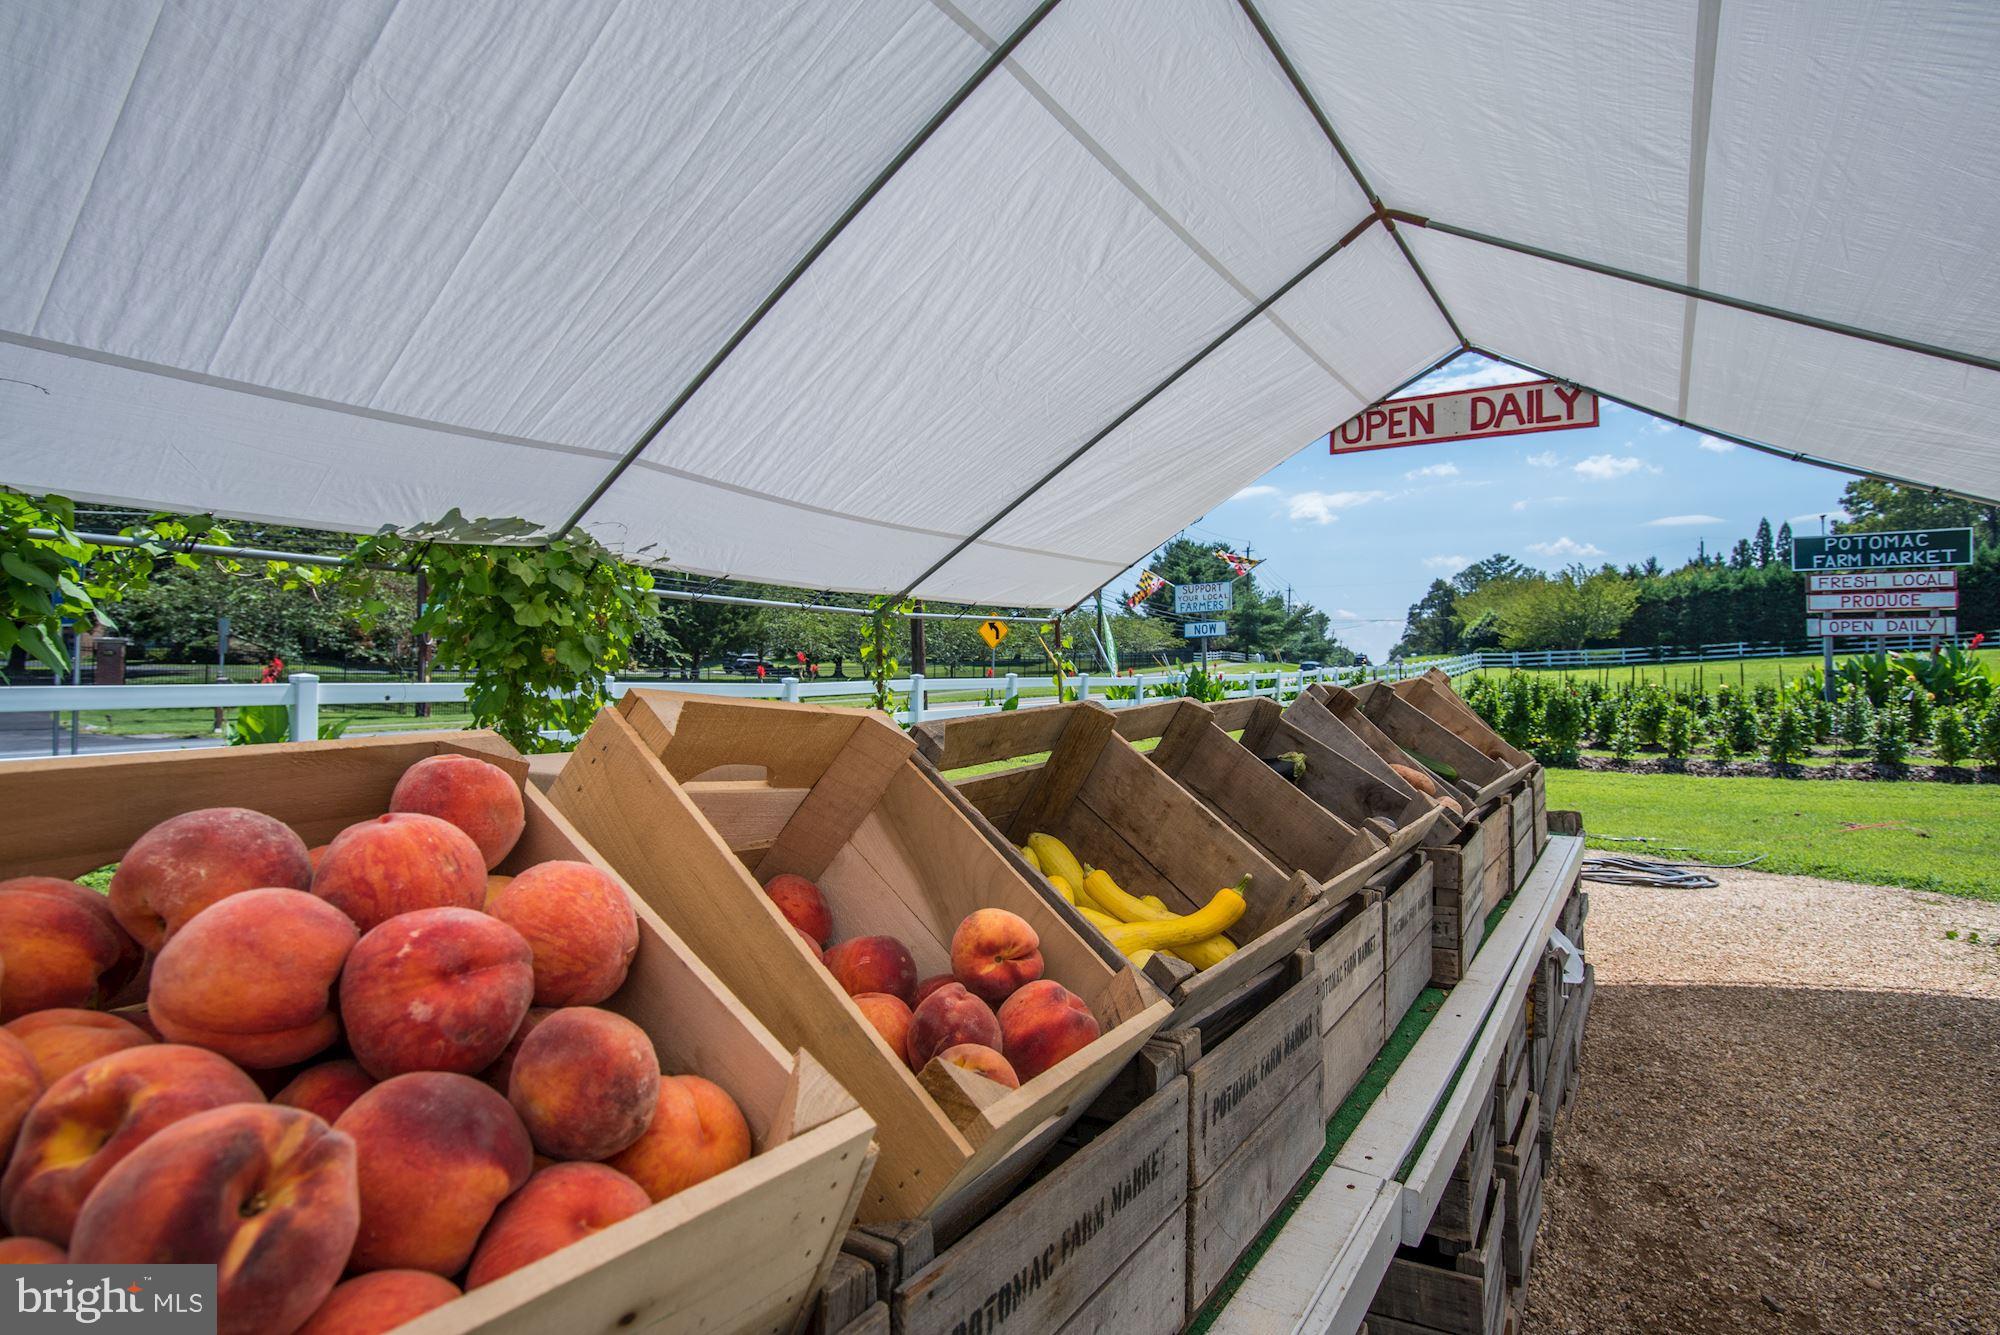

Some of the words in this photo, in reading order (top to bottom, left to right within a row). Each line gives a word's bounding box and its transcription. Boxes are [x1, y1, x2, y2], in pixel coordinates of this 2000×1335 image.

[1341, 403, 1434, 444] OPEN
[1470, 386, 1582, 431] DAILY
[1824, 533, 1929, 551] POTOMAC
[1813, 553, 1862, 568] FARM
[1870, 549, 1957, 566] MARKET
[1182, 583, 1223, 595] SUPPORT
[1818, 576, 1877, 589] FRESH
[1892, 573, 1949, 587] LOCAL
[1180, 601, 1224, 612] FARMERS
[1841, 593, 1921, 608] PRODUCE
[1194, 623, 1217, 635] NOW
[1829, 620, 1873, 633] OPEN
[1887, 619, 1937, 632] DAILY
[1212, 1064, 1258, 1127] POTOMAC
[1260, 1041, 1281, 1081] FARM
[1284, 1013, 1312, 1058] MARKET
[1061, 1197, 1105, 1265] FARM
